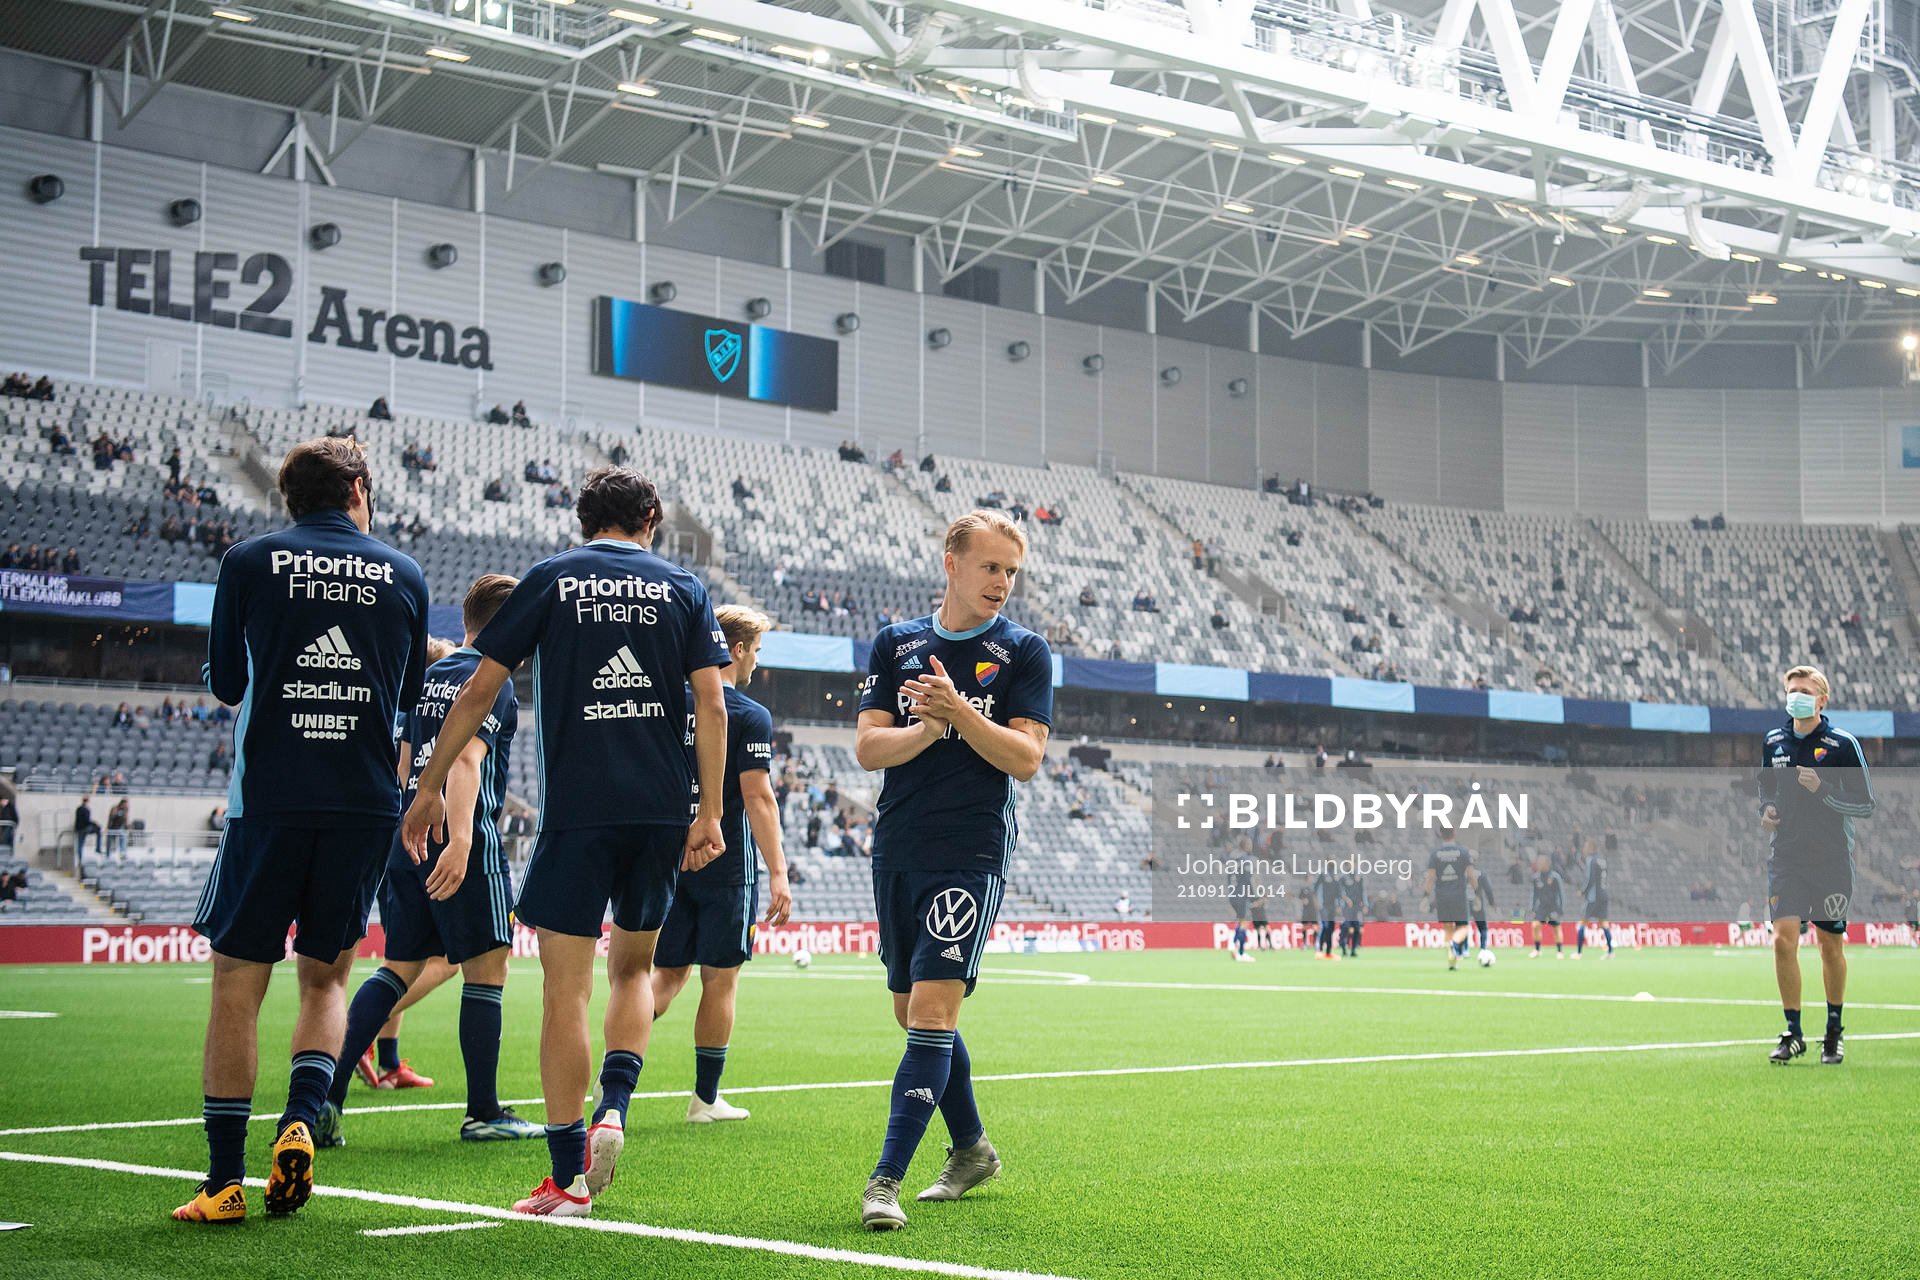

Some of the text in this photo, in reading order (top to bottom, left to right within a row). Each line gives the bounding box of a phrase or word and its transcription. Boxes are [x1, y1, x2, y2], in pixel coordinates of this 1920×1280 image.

[80, 247, 494, 371] TELE2 Arena
[271, 550, 394, 585] Prioritet
[289, 573, 377, 605] Finans
[558, 574, 672, 602] Prioritet
[576, 598, 658, 625] Finans
[296, 652, 362, 670] adidas
[282, 680, 371, 702] stadium
[592, 672, 652, 690] adidas
[291, 713, 359, 730] UNIBET
[583, 700, 665, 721] stadium
[83, 927, 212, 963] Priorite
